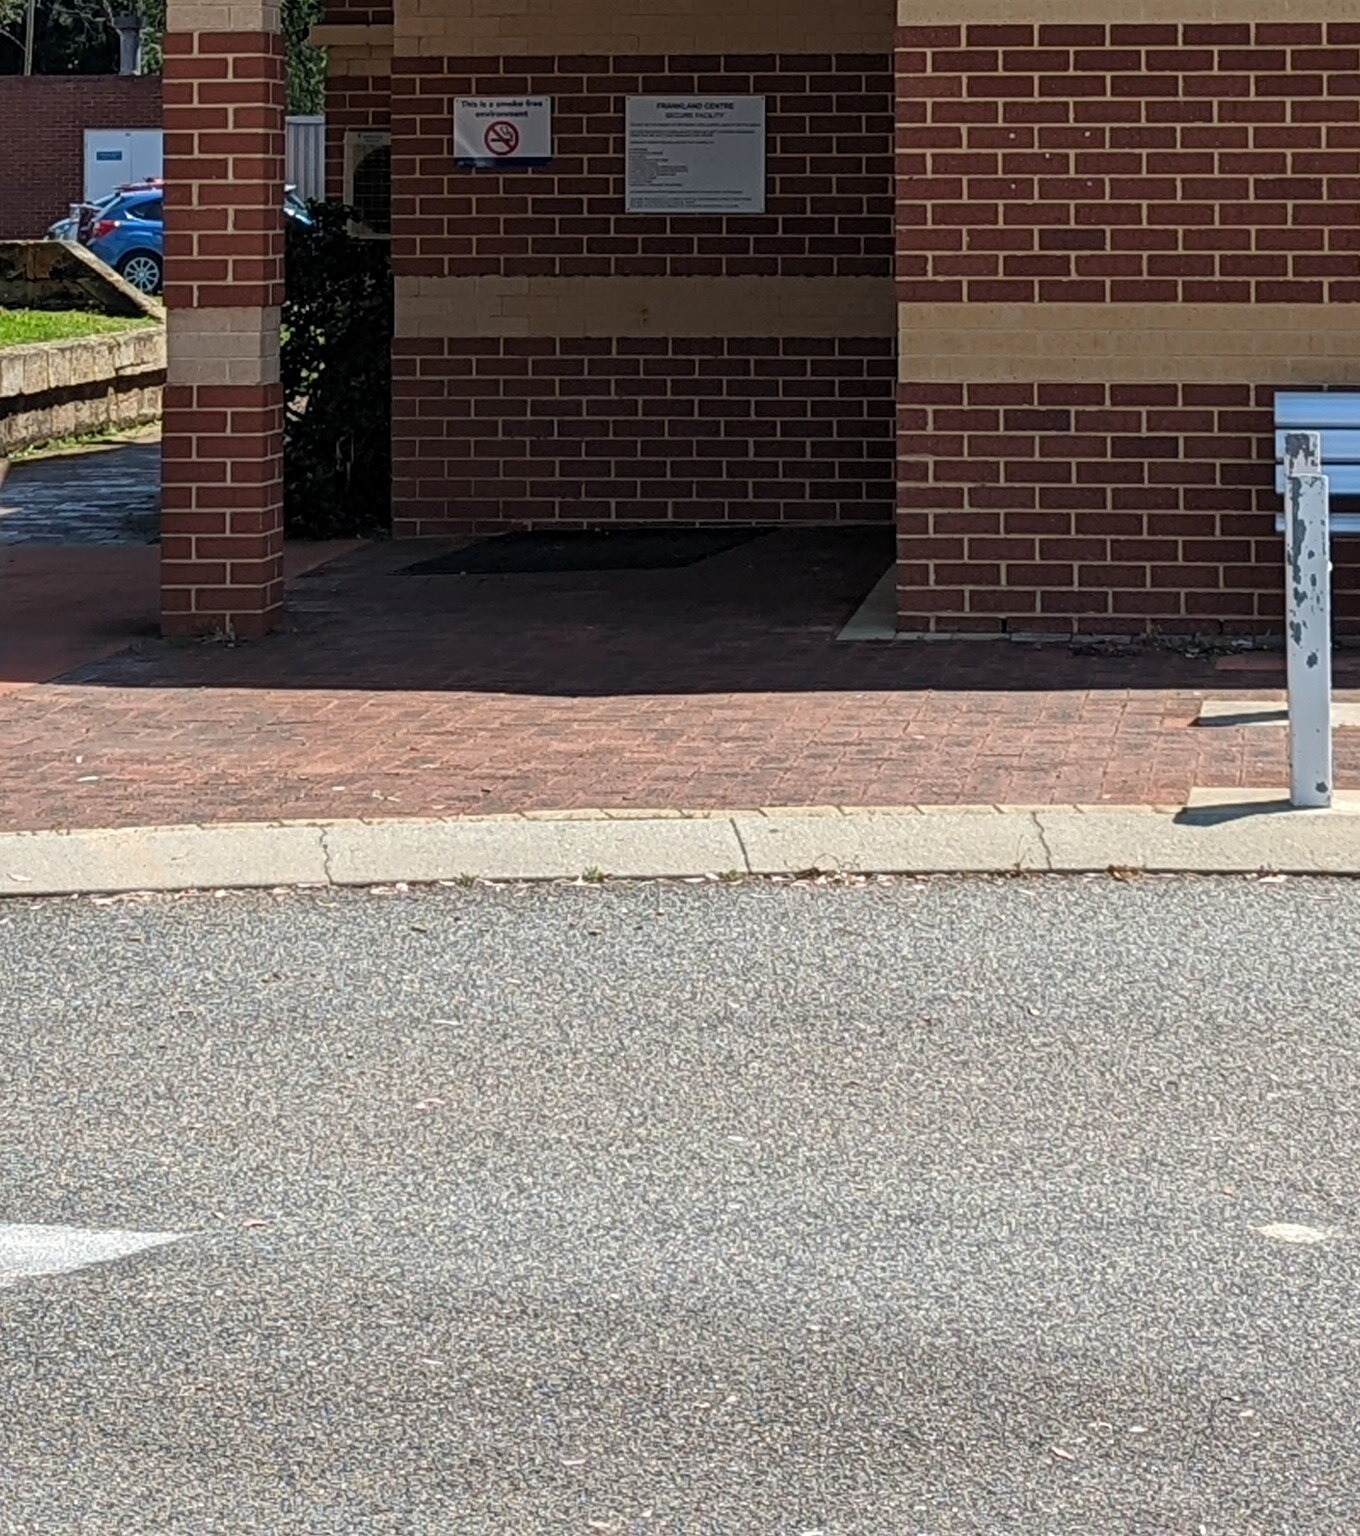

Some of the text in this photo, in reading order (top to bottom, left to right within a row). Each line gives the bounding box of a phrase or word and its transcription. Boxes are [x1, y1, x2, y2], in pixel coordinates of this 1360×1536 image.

[461, 100, 478, 108] This
[480, 100, 487, 108] is
[526, 99, 543, 107] free
[656, 102, 735, 110] FRANKLAND CENTRE
[475, 110, 528, 118] environment
